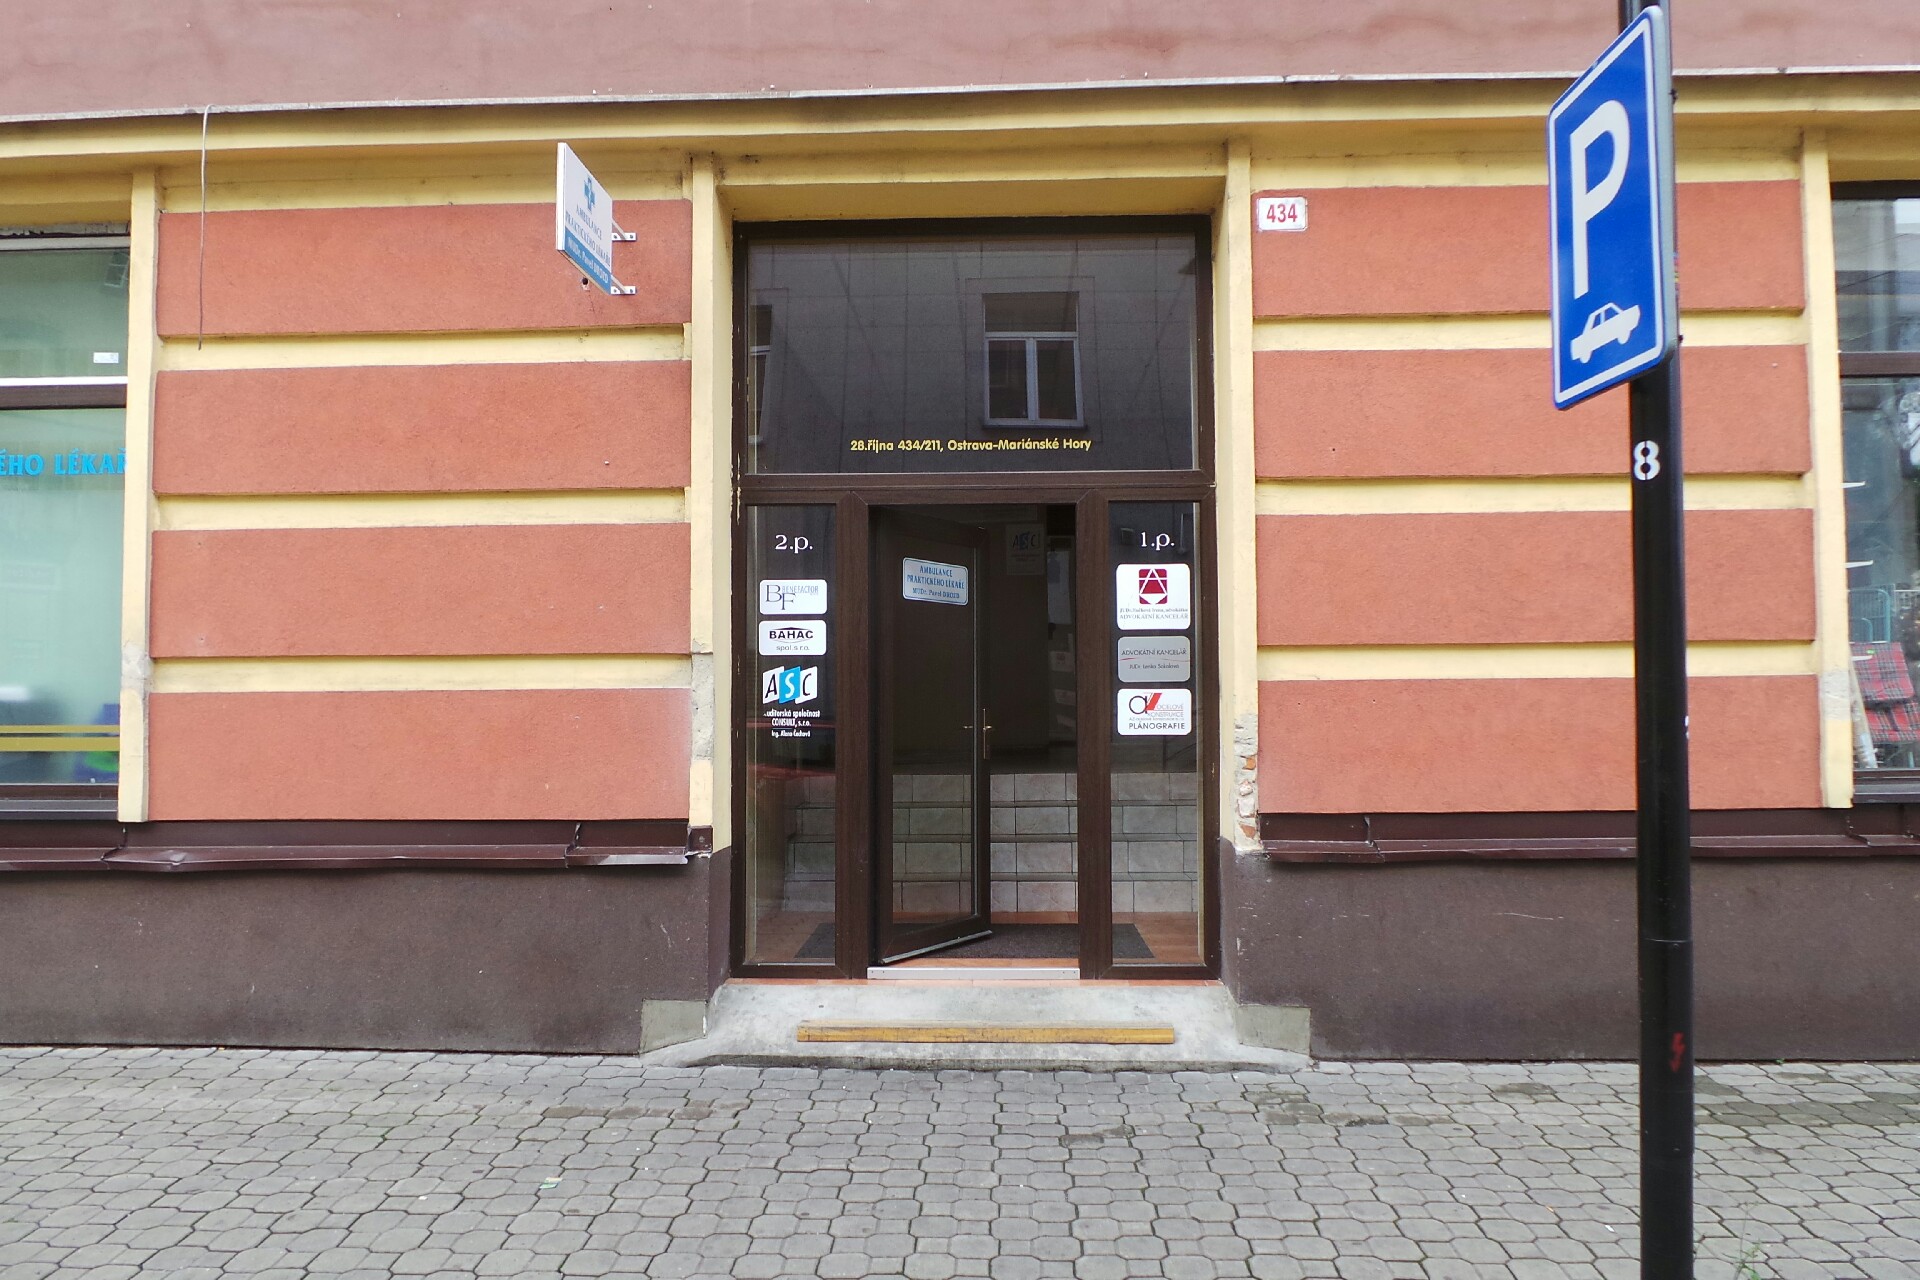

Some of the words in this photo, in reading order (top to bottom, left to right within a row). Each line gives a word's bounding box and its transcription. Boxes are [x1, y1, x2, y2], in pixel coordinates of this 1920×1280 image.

[1570, 100, 1630, 299] P
[576, 204, 602, 240] AMBULANCE
[1266, 203, 1298, 223] 434
[898, 440, 944, 452] 434/211,
[947, 438, 1059, 451] Ostrava-Mariánské
[1063, 438, 1091, 451] Hory
[1633, 440, 1660, 480] 8
[775, 534, 813, 553] 2.p.
[1141, 532, 1175, 550] 1.p.
[919, 565, 953, 577] AMBULANCE
[782, 585, 819, 594] BENEFACTOR
[769, 630, 814, 639] BAHAC
[1121, 648, 1155, 656] ADVOKÁTNÍ
[1156, 647, 1187, 656] KANCELÁŘ
[765, 672, 812, 699] ASC
[763, 707, 791, 717] uditorská
[792, 707, 820, 718] společnost
